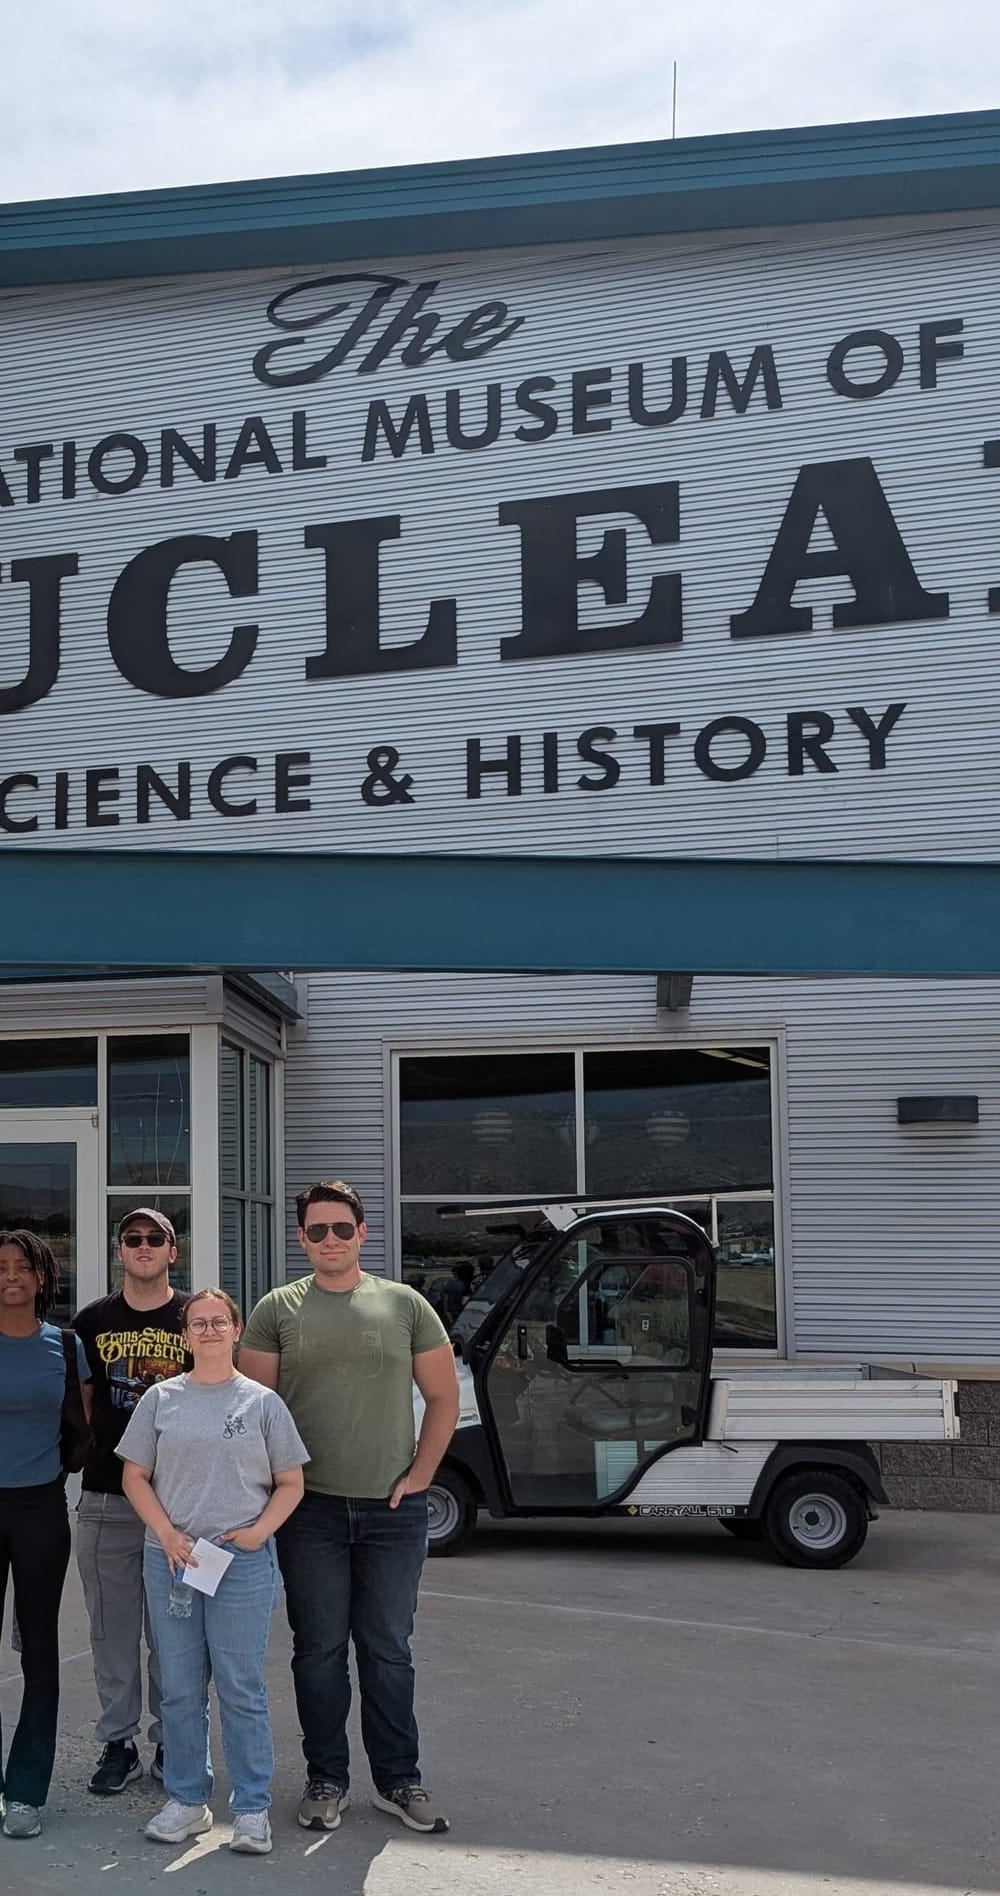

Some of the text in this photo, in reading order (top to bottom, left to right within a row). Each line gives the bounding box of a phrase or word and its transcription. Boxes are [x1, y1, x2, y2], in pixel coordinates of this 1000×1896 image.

[253, 271, 525, 387] The
[361, 344, 783, 462] MUSEUM
[826, 317, 964, 399] OF
[360, 744, 416, 807] &
[466, 702, 908, 799] HISTORY
[100, 1339, 185, 1366] Orchestra
[640, 1505, 735, 1516] CARRYALL 510
